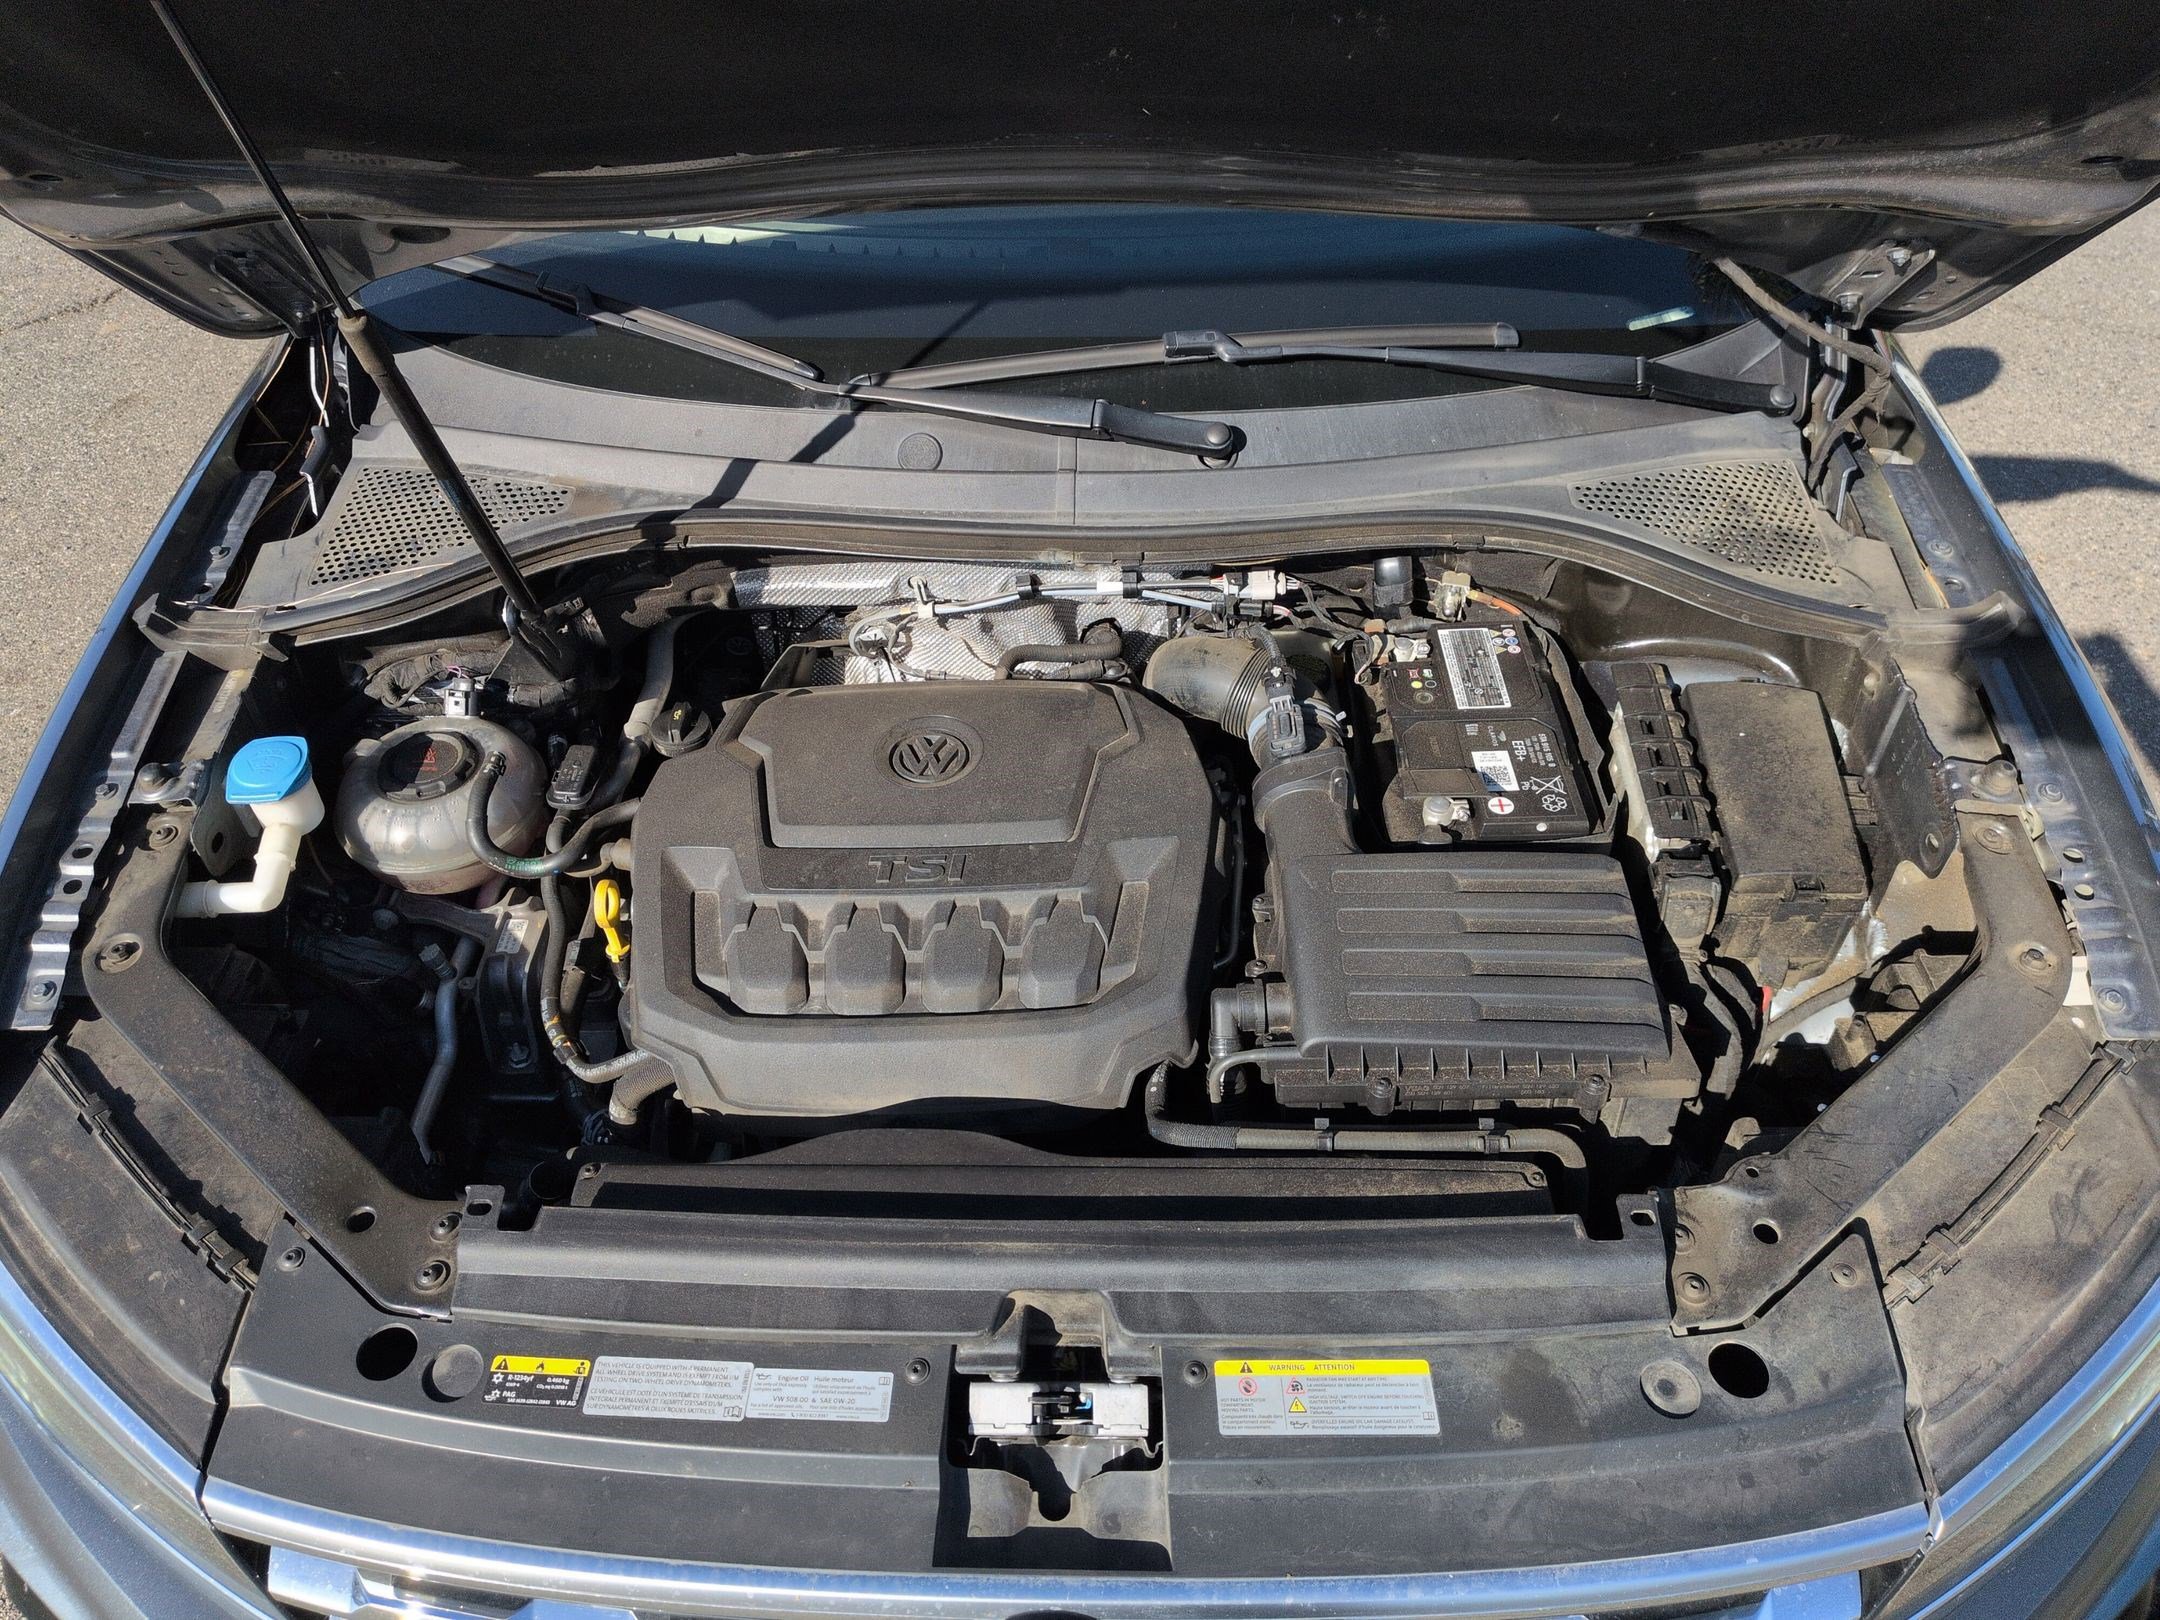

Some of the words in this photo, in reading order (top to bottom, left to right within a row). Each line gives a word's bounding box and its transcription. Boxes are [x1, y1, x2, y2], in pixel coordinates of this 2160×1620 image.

[1487, 725, 1499, 747] CLARIOS
[893, 731, 967, 781] VW
[1511, 740, 1527, 762] EFB+
[1520, 781, 1530, 790] Pb
[868, 854, 968, 883] TSI
[507, 1374, 535, 1383] R-1234yf
